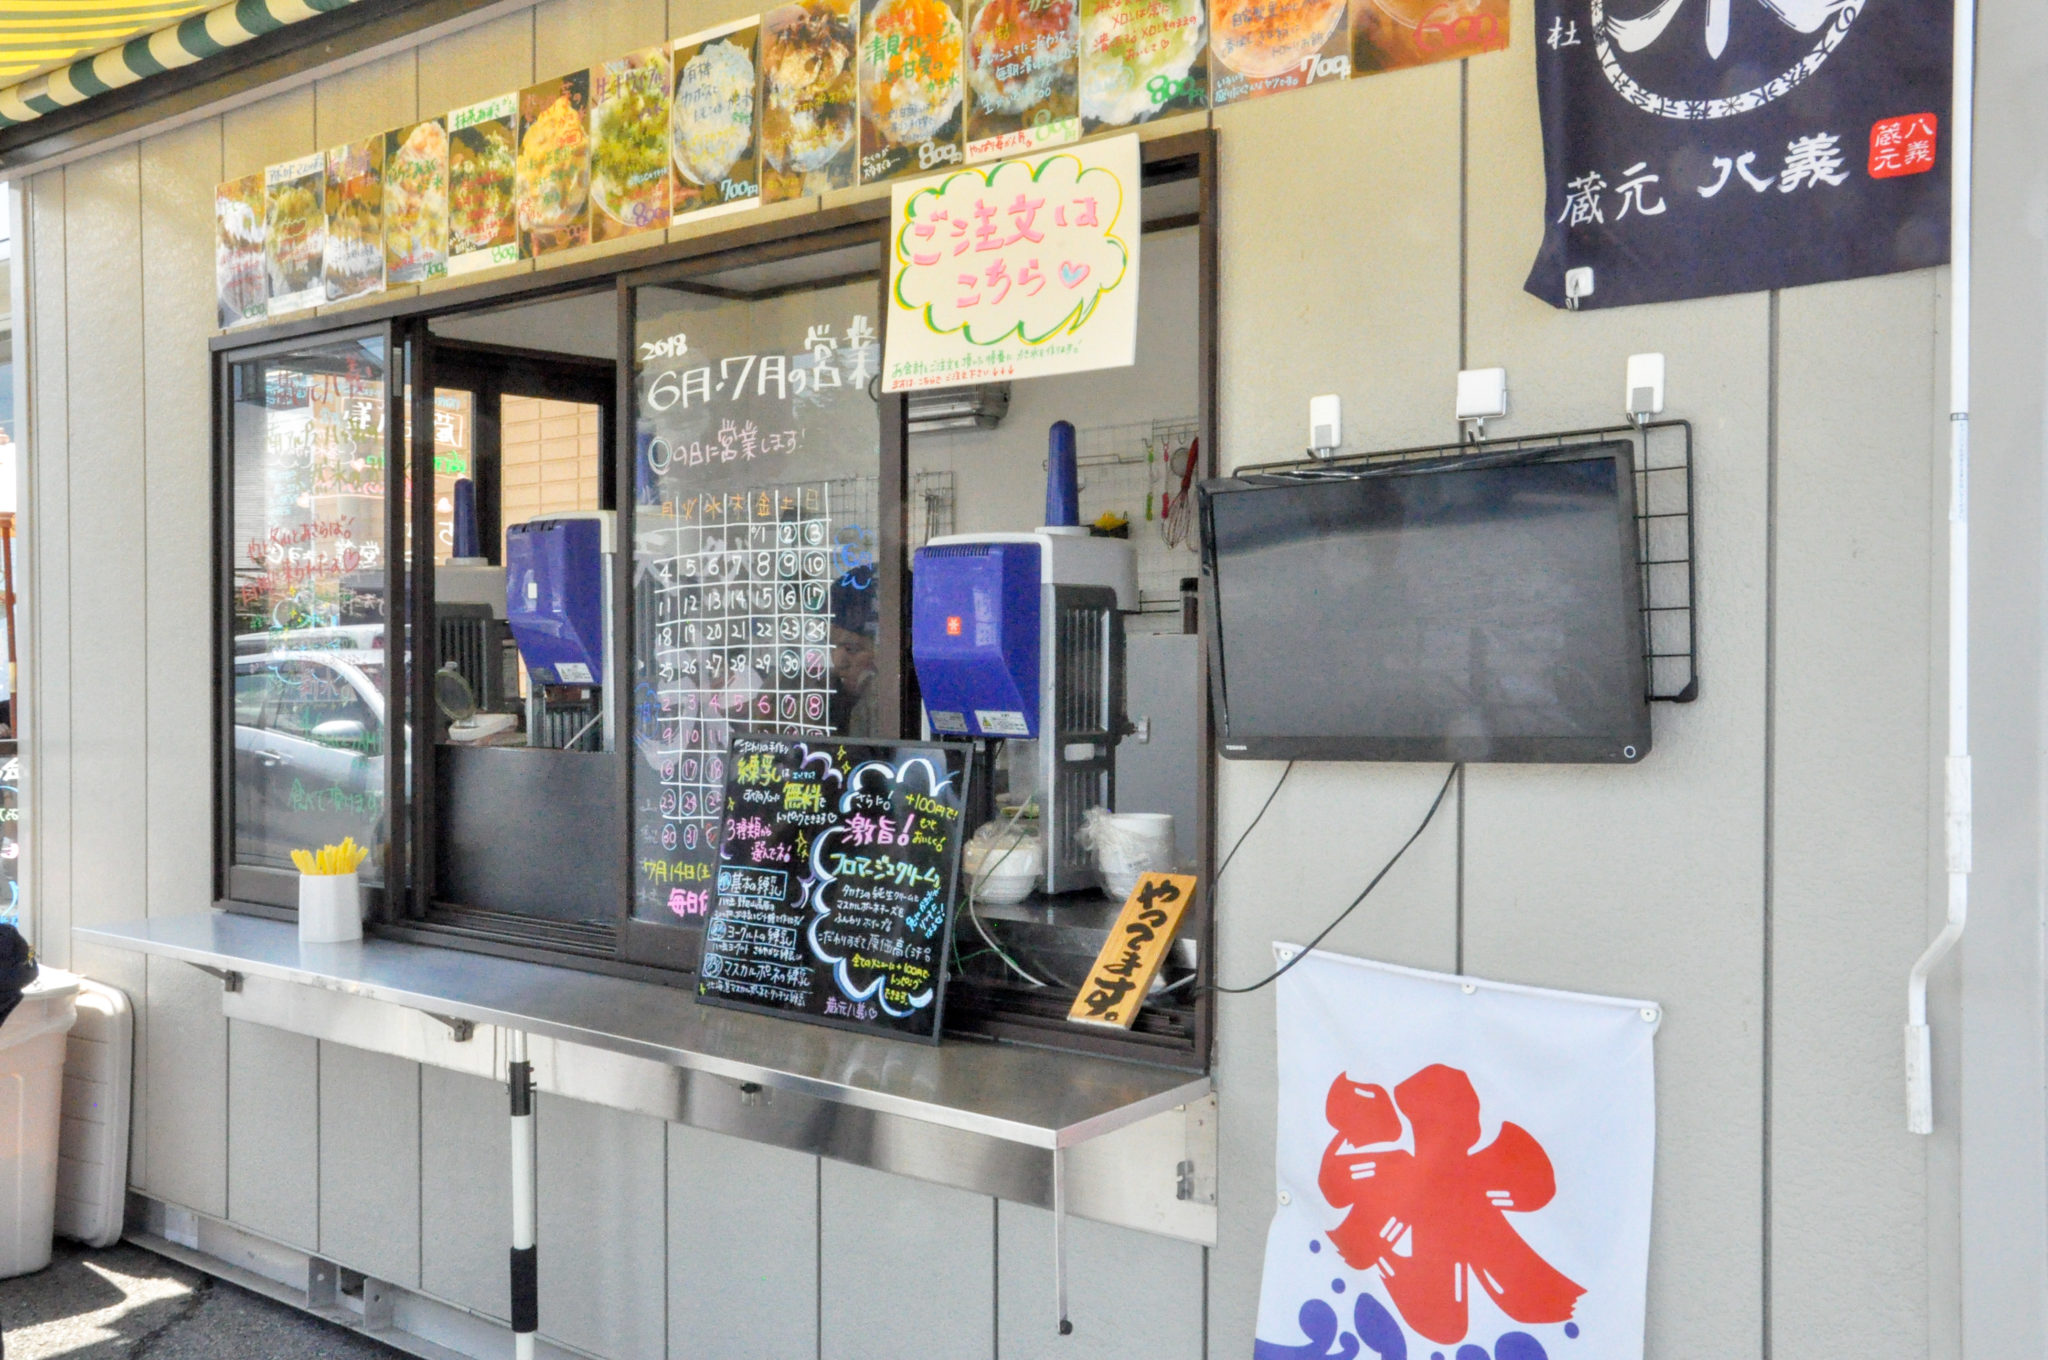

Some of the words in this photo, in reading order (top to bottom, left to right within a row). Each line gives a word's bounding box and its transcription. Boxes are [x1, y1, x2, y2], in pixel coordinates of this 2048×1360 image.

[1557, 162, 1666, 228] 蔵元
[1697, 131, 1850, 198] 八義
[913, 193, 1099, 267] ご注文は
[956, 257, 1046, 309] こちら
[639, 332, 688, 360] 2018
[756, 490, 771, 517] 金
[780, 496, 795, 510] 土
[782, 525, 794, 543] 2
[809, 525, 821, 542] 3
[659, 563, 673, 579] 4
[685, 559, 697, 577] 5
[707, 557, 720, 575] 6
[730, 555, 743, 576] 7
[756, 552, 771, 577] 8
[782, 554, 796, 577] 9
[807, 556, 825, 573] 10
[658, 597, 672, 617] 11
[683, 595, 698, 615] 12
[707, 592, 722, 612] 13
[730, 589, 747, 610] 14
[755, 587, 773, 610] 15
[779, 589, 797, 606] 16
[806, 587, 826, 611] 17
[657, 627, 673, 647] 18
[684, 623, 697, 644] 19
[705, 623, 723, 641] 20
[731, 621, 746, 641] 21
[756, 622, 774, 638] 22
[780, 621, 800, 638] 23
[807, 621, 826, 639] 24
[658, 663, 674, 682] 25
[681, 658, 697, 675] 26
[705, 654, 723, 678] 27
[729, 653, 747, 674] 28
[755, 654, 771, 674] 29
[782, 655, 799, 674] 30
[661, 698, 672, 712] 2
[687, 693, 697, 711] 3
[708, 693, 722, 714] 4
[734, 695, 744, 713] 5
[757, 694, 771, 714] 6
[784, 694, 796, 715] 7
[808, 695, 821, 718] 8
[662, 727, 673, 744] 9
[685, 728, 700, 744] 10
[1084, 879, 1181, 1022] やってます。
[1317, 1062, 1589, 1346] 氷
